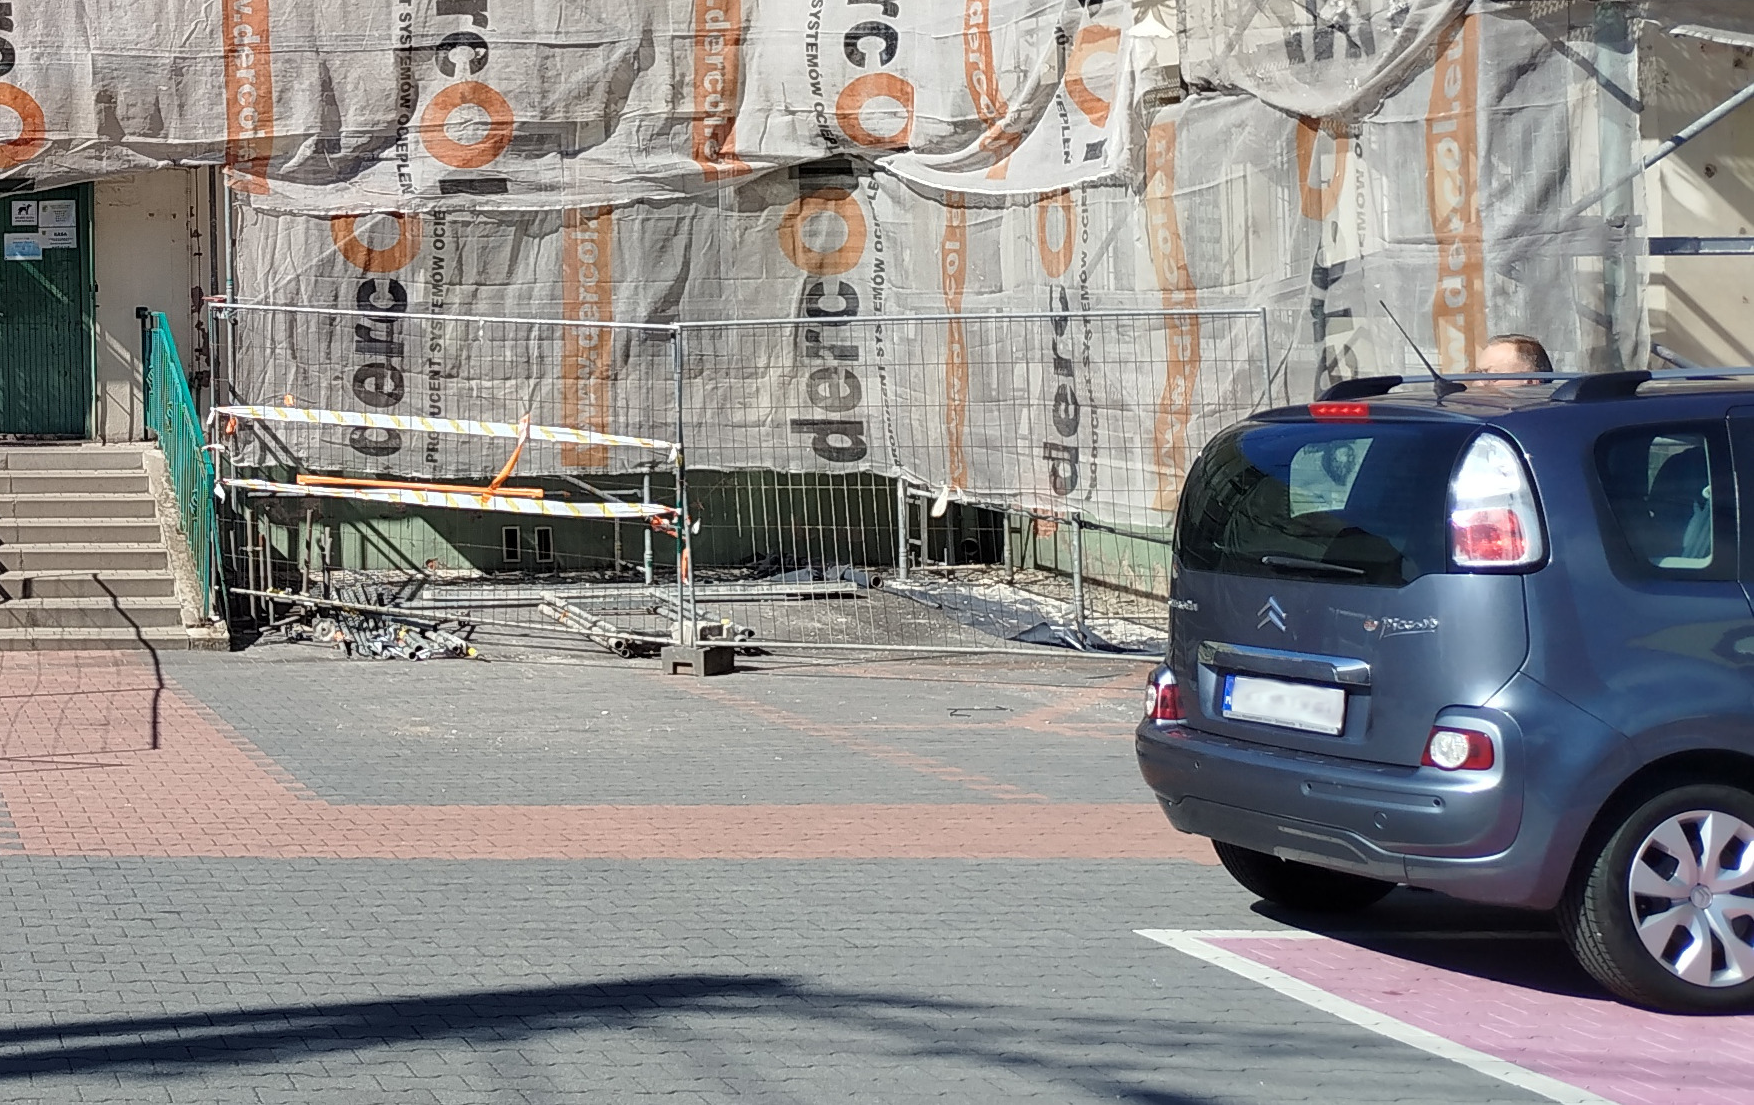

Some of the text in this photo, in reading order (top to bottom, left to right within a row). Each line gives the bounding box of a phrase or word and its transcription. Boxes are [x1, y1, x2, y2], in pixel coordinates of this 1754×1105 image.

[398, 11, 414, 109] SYSTEMÓW
[330, 213, 423, 457] derco
[426, 358, 443, 464] PROUCENT
[1037, 188, 1080, 496] derco
